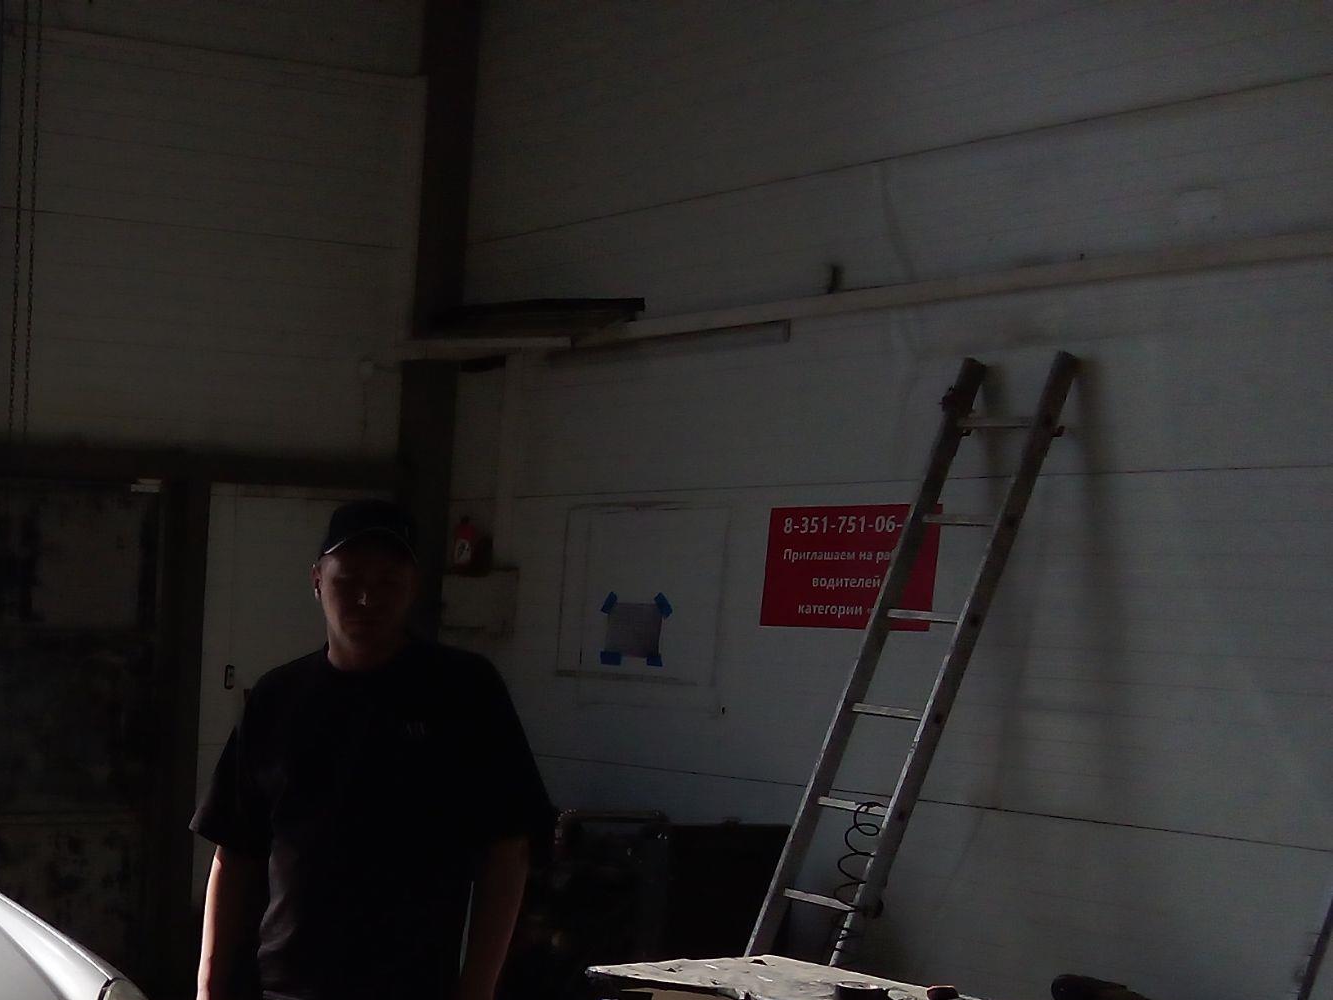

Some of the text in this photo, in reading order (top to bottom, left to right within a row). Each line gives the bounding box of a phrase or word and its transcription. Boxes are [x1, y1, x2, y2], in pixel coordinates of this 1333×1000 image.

[783, 514, 904, 534] 8-351-751-06-
[783, 548, 891, 564] Приглашаем на ра
[811, 575, 881, 590] водителей
[797, 603, 863, 619] категории
